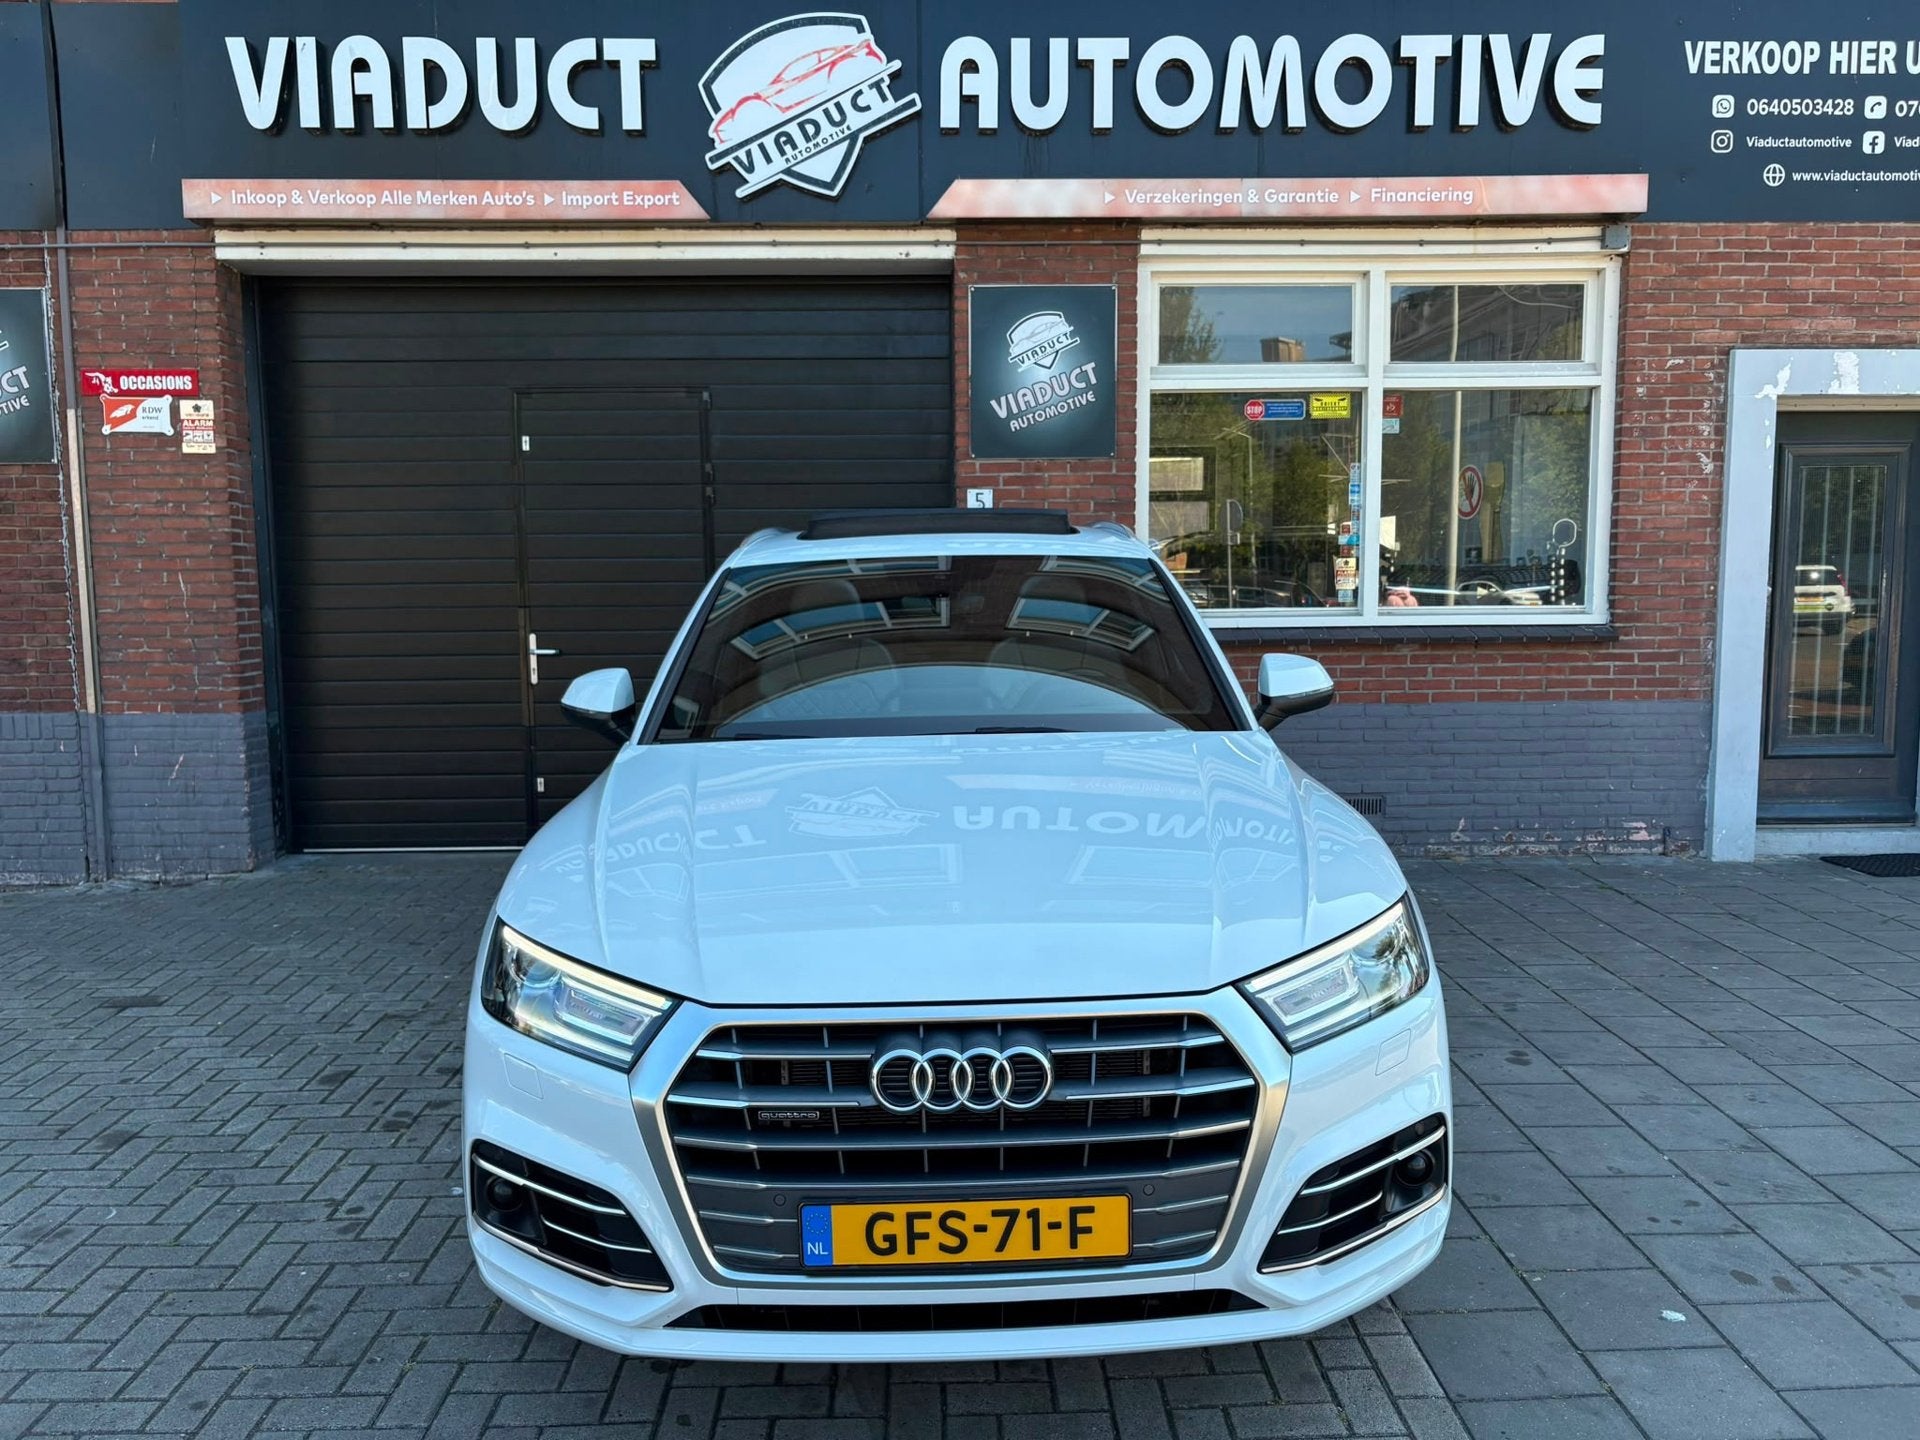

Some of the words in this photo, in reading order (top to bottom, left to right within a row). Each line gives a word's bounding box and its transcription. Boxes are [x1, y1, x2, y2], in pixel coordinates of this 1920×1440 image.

[1684, 40, 1821, 75] VERKOOP
[1829, 40, 1897, 75] HIER
[224, 34, 657, 132] VIADUCT
[940, 33, 1605, 131] AUTOMOTIVE
[1746, 98, 1855, 116] 0640503428
[1894, 100, 1920, 117] 07
[732, 77, 895, 175] VIADUCT
[784, 125, 853, 165] AUTOMOTIVE
[1746, 136, 1853, 148] Viaductautomotive
[231, 189, 288, 208] Inkoop
[290, 189, 304, 206] &
[307, 189, 377, 208] Verkoop
[380, 190, 412, 205] Alle
[416, 190, 478, 206] Merken
[482, 191, 535, 206] Auto's
[562, 191, 619, 209] Import
[623, 191, 680, 209] Export
[1124, 188, 1242, 207] Verzekeringen
[1247, 189, 1259, 204] &
[1264, 187, 1340, 204] Garantie
[1371, 187, 1474, 205] Financiering
[1017, 332, 1071, 366] VIADUCT
[0, 366, 30, 397] CT
[120, 375, 193, 390] OCCASIONS
[989, 361, 1098, 420] VIADUCT
[0, 394, 30, 416] TIVE
[141, 406, 163, 414] RDW
[1009, 390, 1097, 433] AUTOMOTIVE
[1246, 405, 1263, 415] STOP
[182, 419, 214, 427] ALARM
[975, 492, 986, 510] 5
[865, 1205, 1095, 1256] GFS-71-F
[807, 1241, 829, 1255] NL
